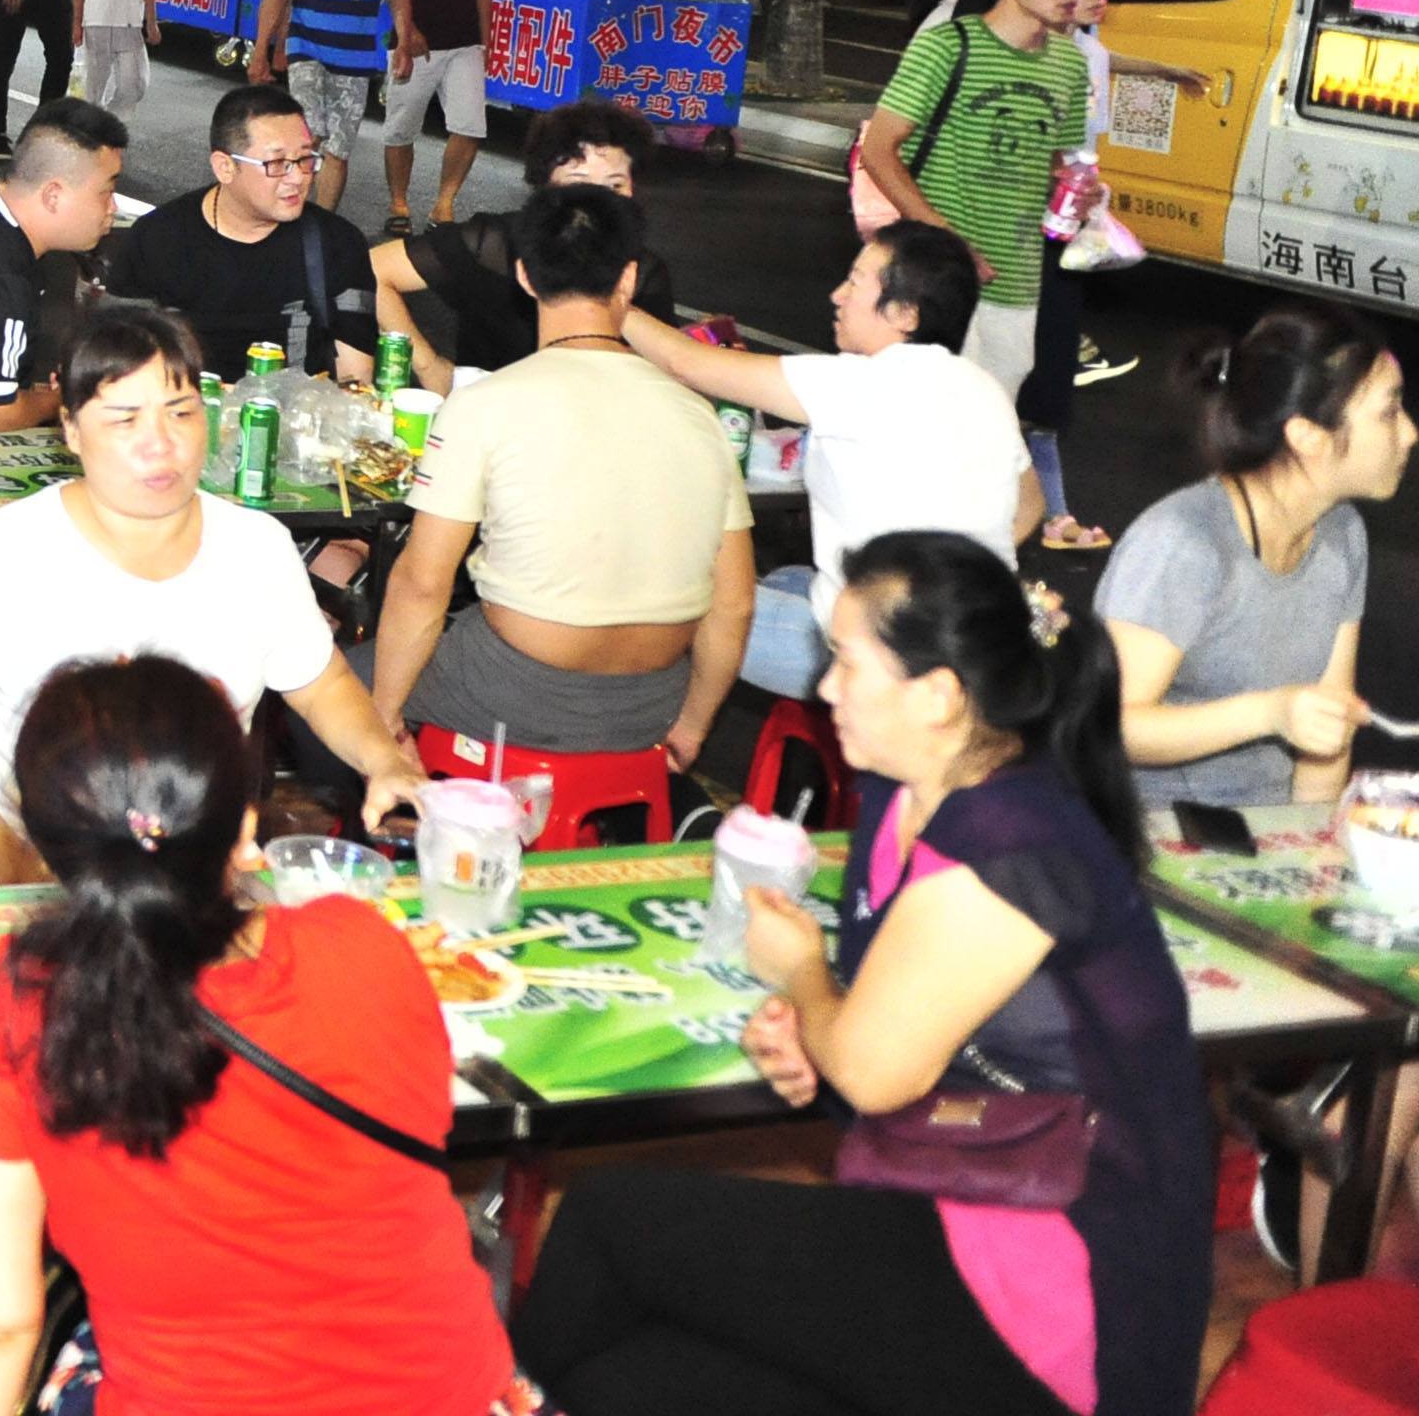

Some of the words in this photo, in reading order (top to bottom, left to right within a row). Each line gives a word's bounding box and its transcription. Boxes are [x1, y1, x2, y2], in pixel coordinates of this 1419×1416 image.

[588, 4, 744, 65] 南门夜市
[595, 64, 728, 95] 胖子贴膜
[615, 93, 707, 121] 欢迎你
[1261, 231, 1408, 301] 海南台
